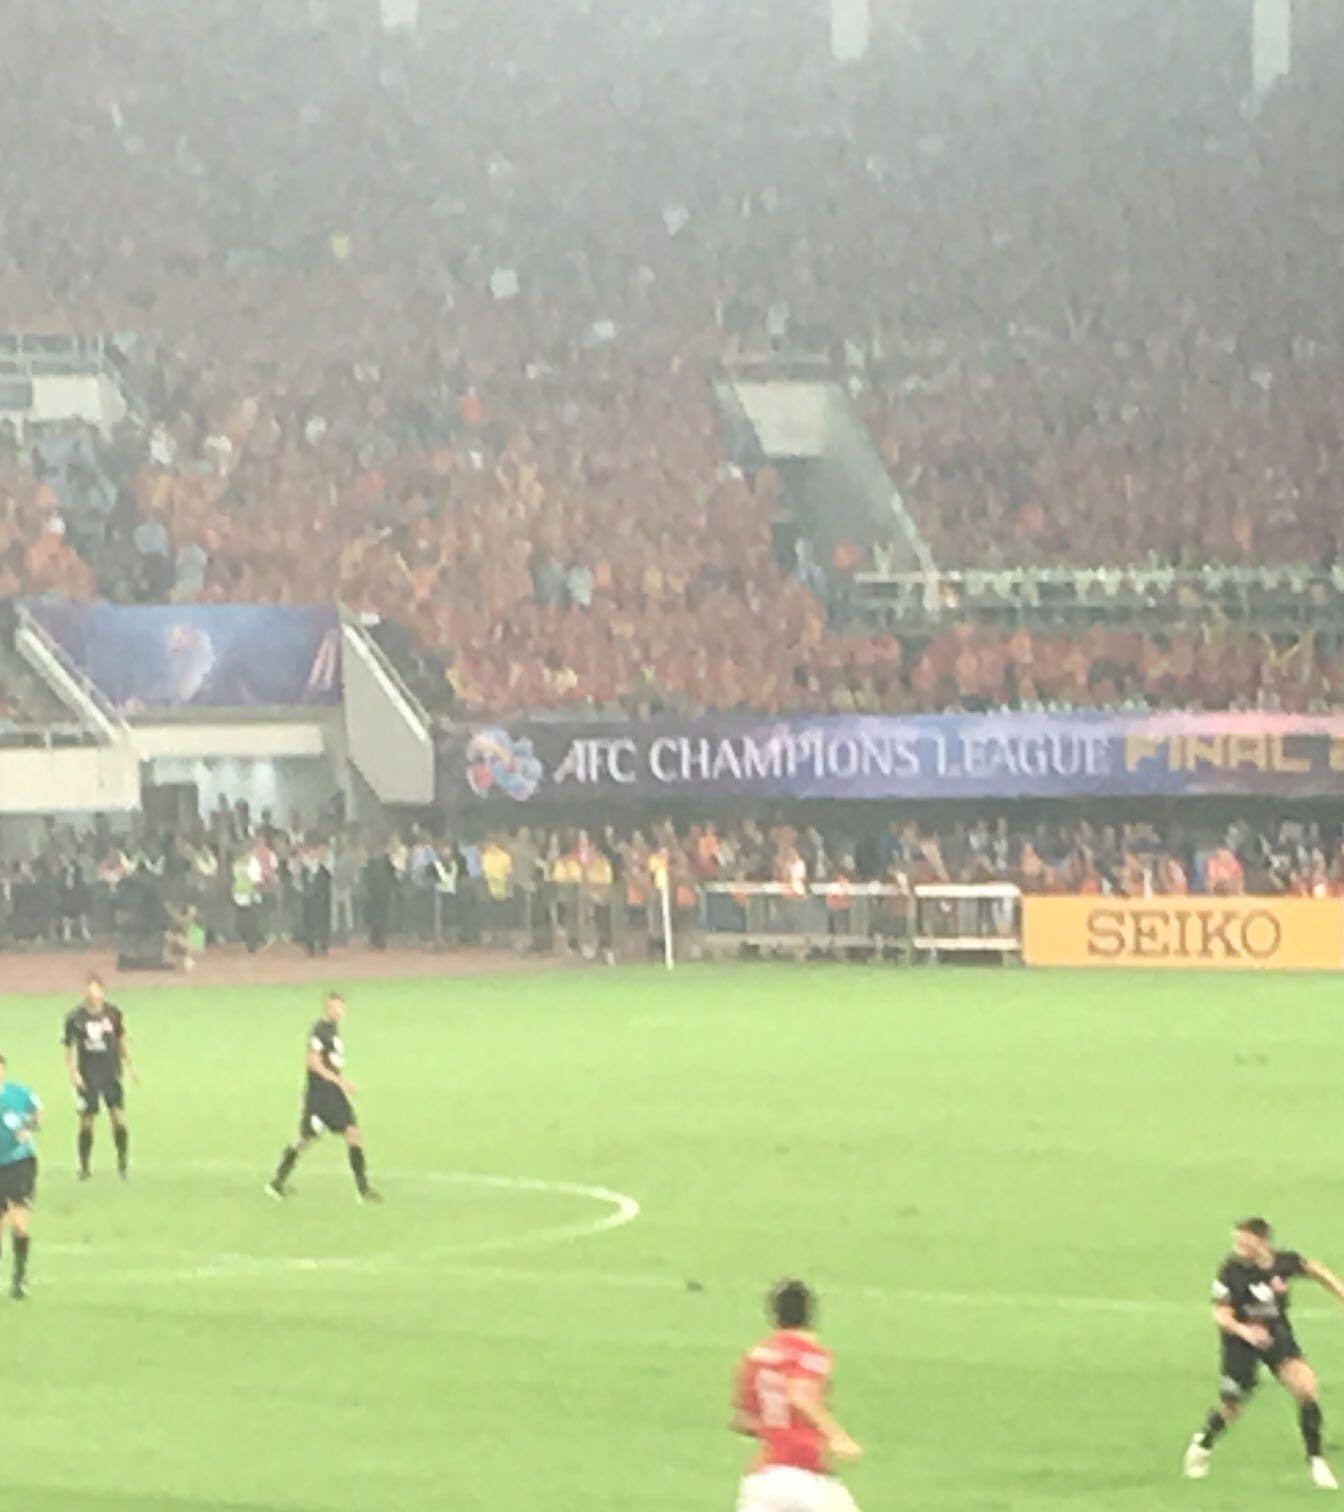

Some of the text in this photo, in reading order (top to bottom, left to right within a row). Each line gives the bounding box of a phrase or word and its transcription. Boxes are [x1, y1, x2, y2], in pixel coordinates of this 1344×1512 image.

[553, 737, 637, 782] AFC
[649, 731, 921, 783] CHAMPIONS
[934, 730, 1110, 777] LEAGUE
[1124, 732, 1311, 773] FINAL
[1087, 909, 1282, 958] SEIKO
